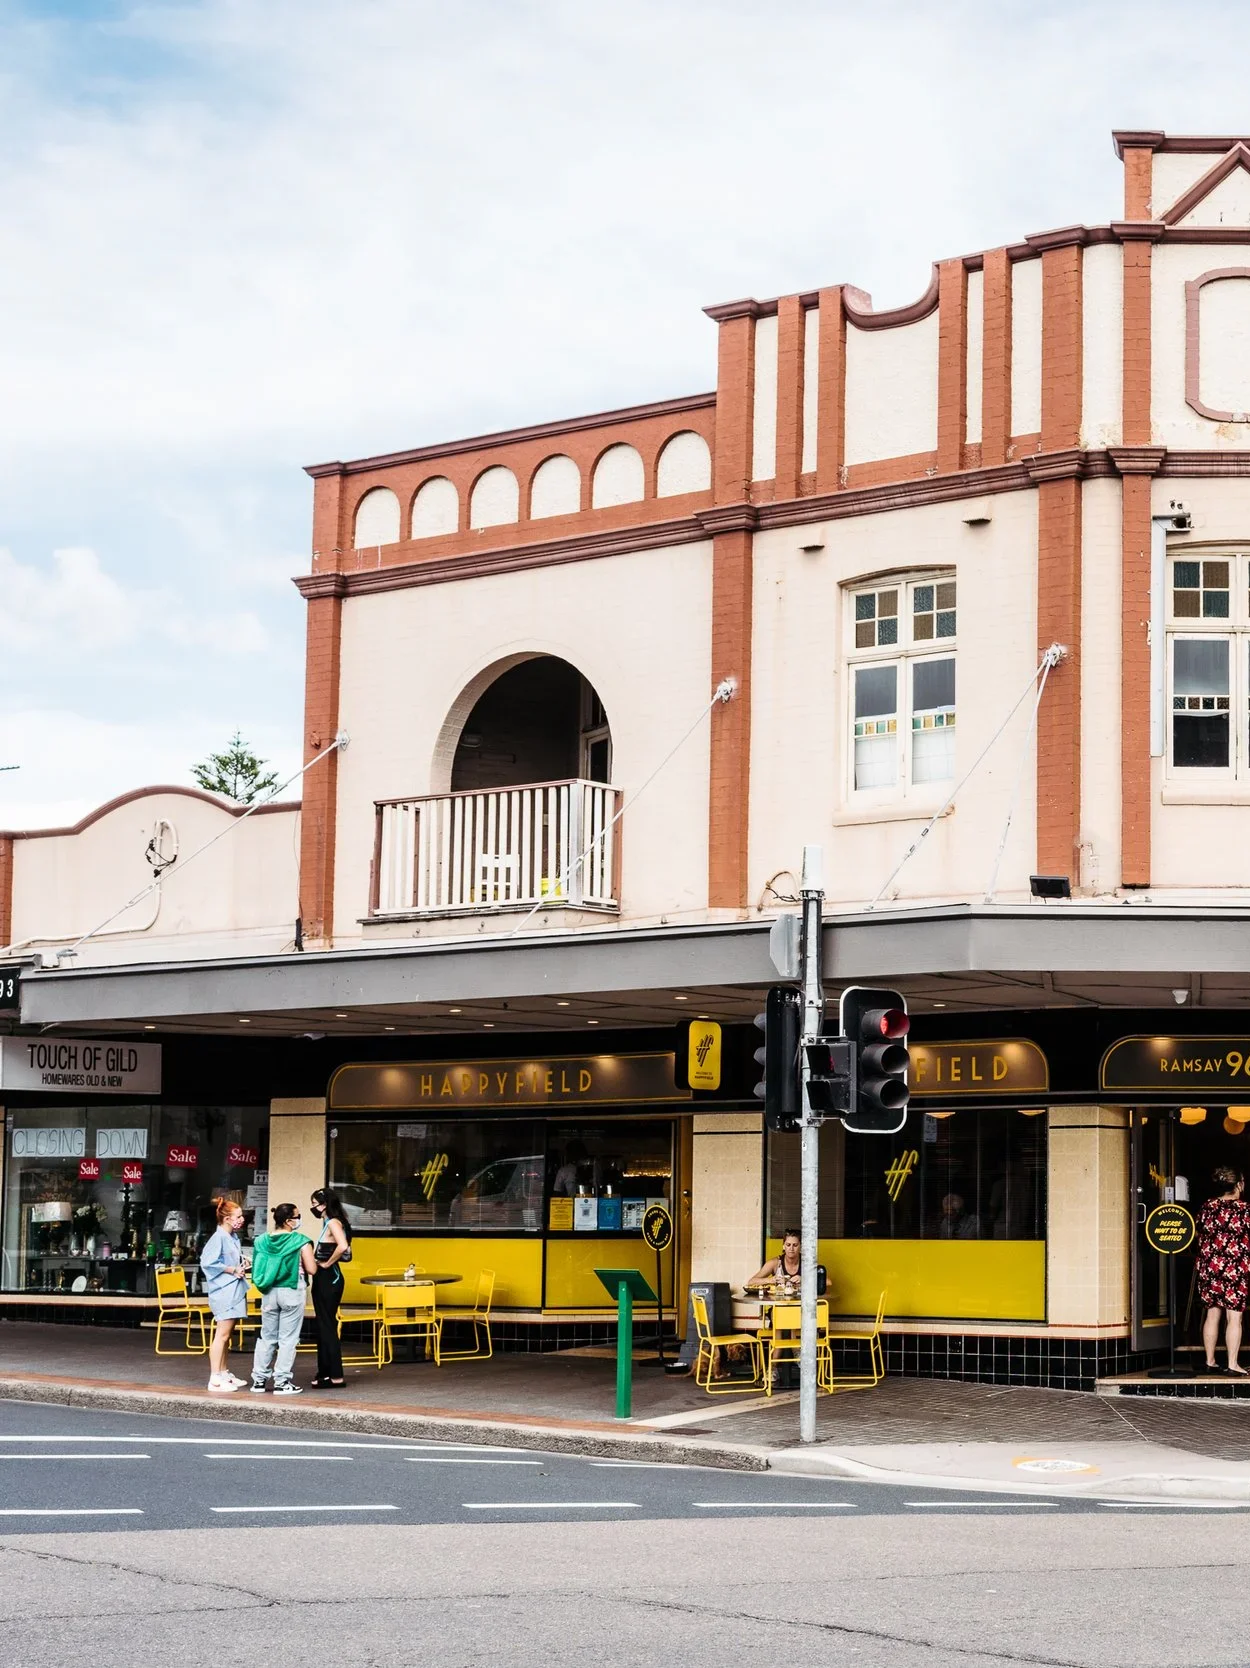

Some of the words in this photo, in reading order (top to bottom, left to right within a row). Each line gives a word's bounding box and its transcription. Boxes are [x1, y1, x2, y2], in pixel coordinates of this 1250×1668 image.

[27, 1043, 78, 1070] TOUCH
[83, 1046, 102, 1071] OF
[106, 1047, 138, 1073] GILD
[1160, 1058, 1223, 1073] RAMSAY
[42, 1072, 85, 1086] HOMEWARES
[86, 1074, 100, 1087] OLD
[101, 1075, 106, 1087] &
[107, 1076, 123, 1087] NEW
[420, 1068, 593, 1097] HAPPYFIELD
[13, 1128, 85, 1156] CLOSING
[97, 1129, 147, 1156] DOWN
[169, 1149, 197, 1164] Sale
[229, 1148, 257, 1164] Sale
[80, 1162, 99, 1176] Sale
[123, 1166, 142, 1180] Sale
[1157, 1207, 1185, 1217] WELCOME!
